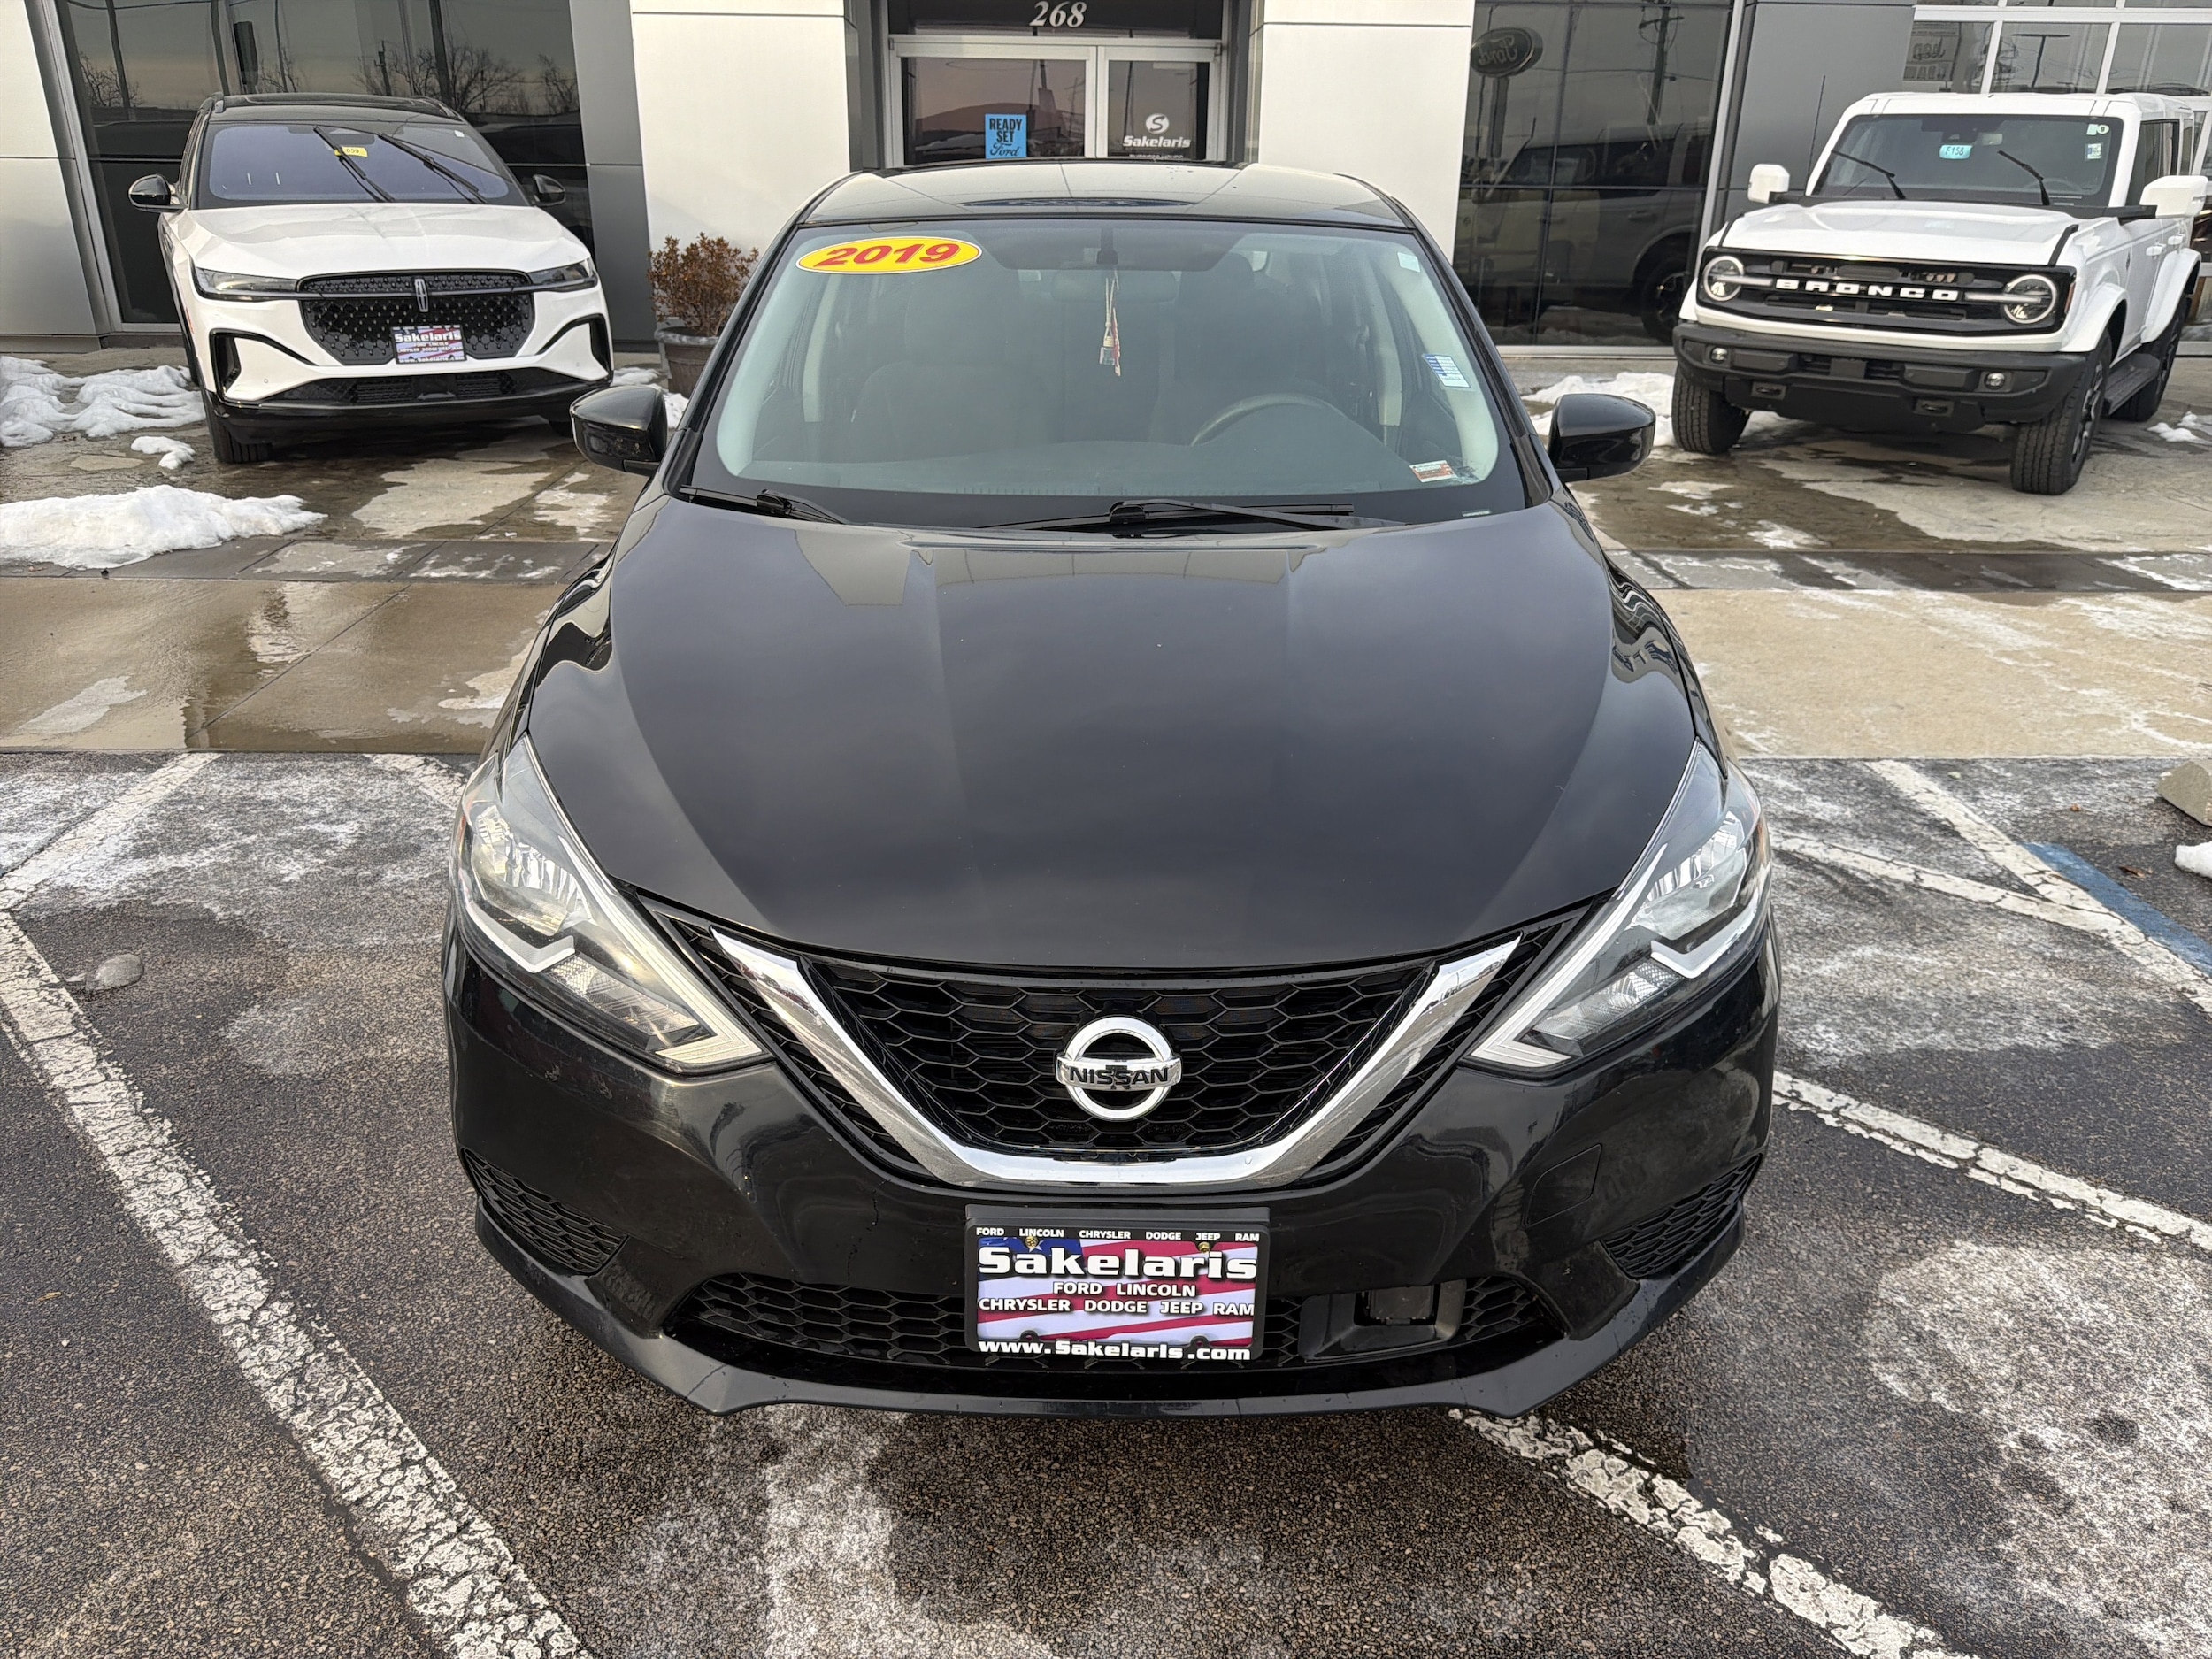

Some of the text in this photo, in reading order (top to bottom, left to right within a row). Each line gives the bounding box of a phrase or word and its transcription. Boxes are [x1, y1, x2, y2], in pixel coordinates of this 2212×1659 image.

[1029, 1, 1087, 27] 268
[989, 118, 1022, 131] READY
[996, 130, 1014, 142] SET
[1123, 135, 1191, 148] Sakelaris
[989, 142, 1022, 157] Ford
[813, 243, 961, 267] 2019
[1776, 279, 1959, 301] BRONCO
[395, 332, 462, 342] Sakelaris
[1070, 1066, 1169, 1085] NISSAN
[976, 1227, 1259, 1242] FORD LINCOLN CHRYSLER DODGE JEEP RAM
[979, 1247, 1257, 1279] Sakelaris
[1053, 1282, 1196, 1297] FORD LINCOLN
[979, 1298, 1254, 1316] CHRYSLER DODGE JEEP RAM
